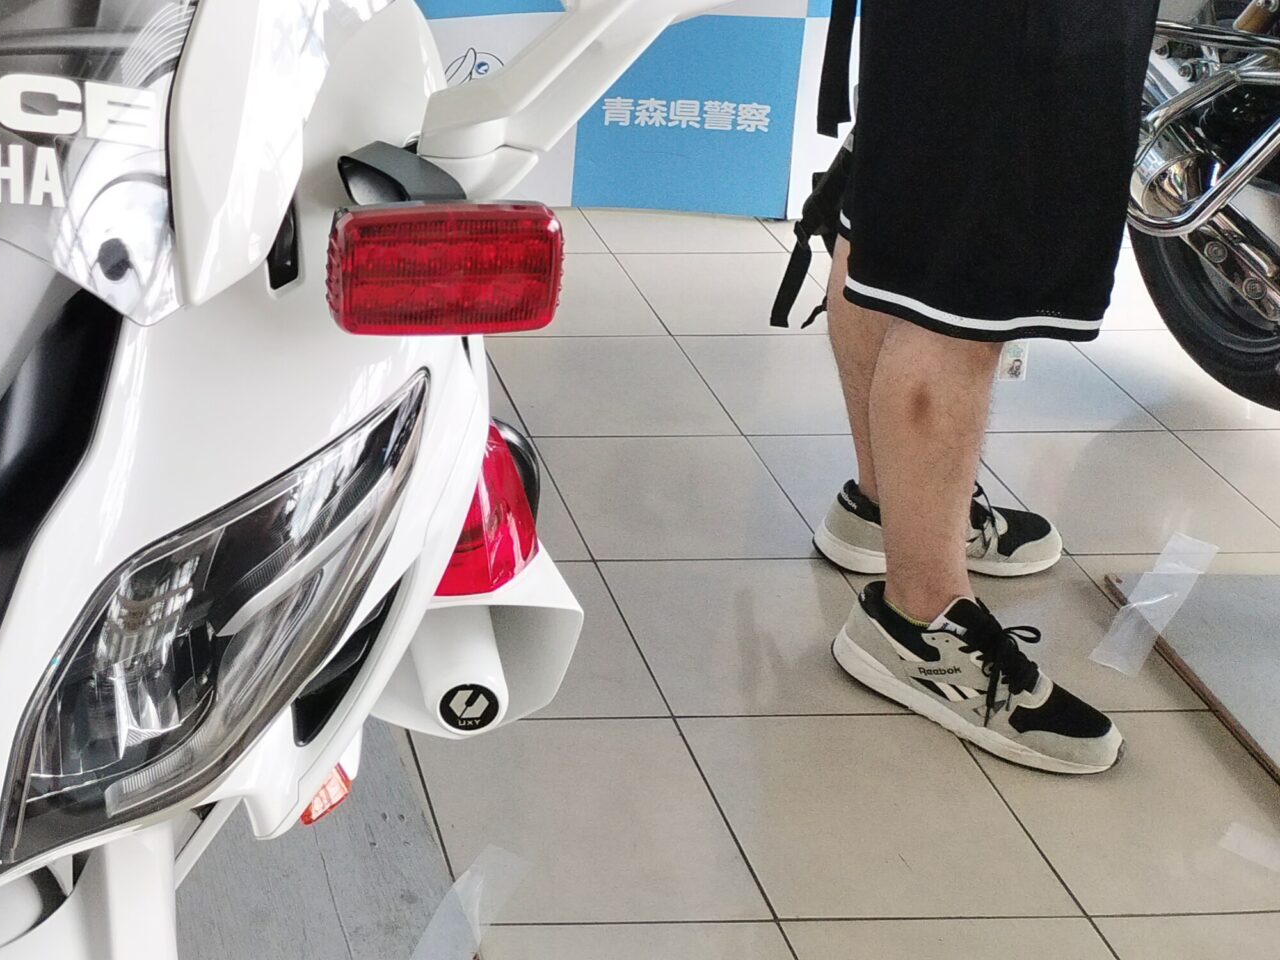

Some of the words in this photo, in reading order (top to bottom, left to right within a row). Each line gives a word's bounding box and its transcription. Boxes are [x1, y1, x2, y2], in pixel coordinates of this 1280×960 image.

[602, 95, 772, 134] 青森県警察
[918, 665, 962, 677] Reebok
